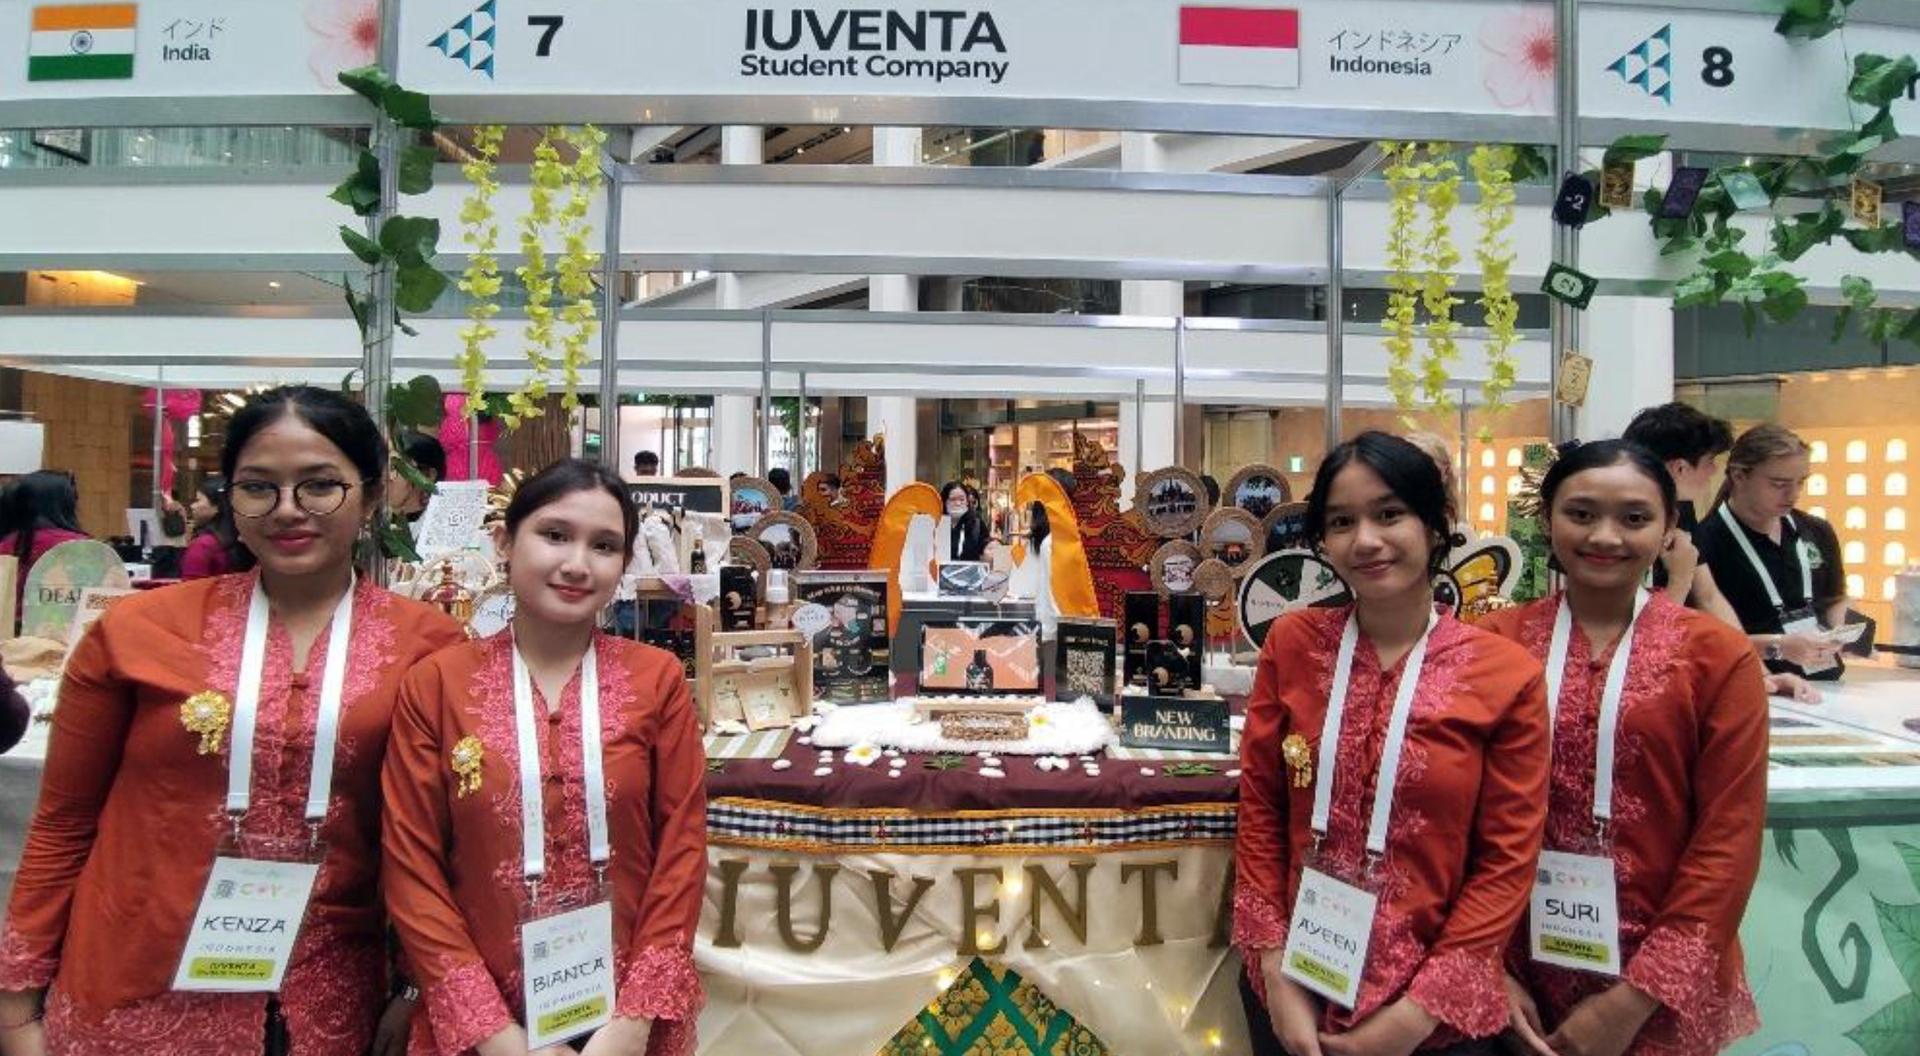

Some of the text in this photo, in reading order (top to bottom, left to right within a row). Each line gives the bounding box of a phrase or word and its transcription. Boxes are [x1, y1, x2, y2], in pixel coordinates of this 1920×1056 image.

[161, 18, 224, 40] インド
[527, 15, 564, 56] 7
[745, 9, 1007, 52] IUVENTA
[1328, 29, 1462, 54] インドネシア
[163, 44, 211, 61] India
[1330, 55, 1432, 75] Indonesia
[740, 54, 1009, 83] Student Company
[1701, 46, 1735, 88] 8
[1156, 709, 1194, 725] NEW
[1133, 723, 1216, 742] BRANDING
[1545, 898, 1600, 923] SURI
[202, 914, 287, 934] KENZA
[1297, 917, 1358, 955] AYEEN
[533, 956, 606, 994] BIANCA
